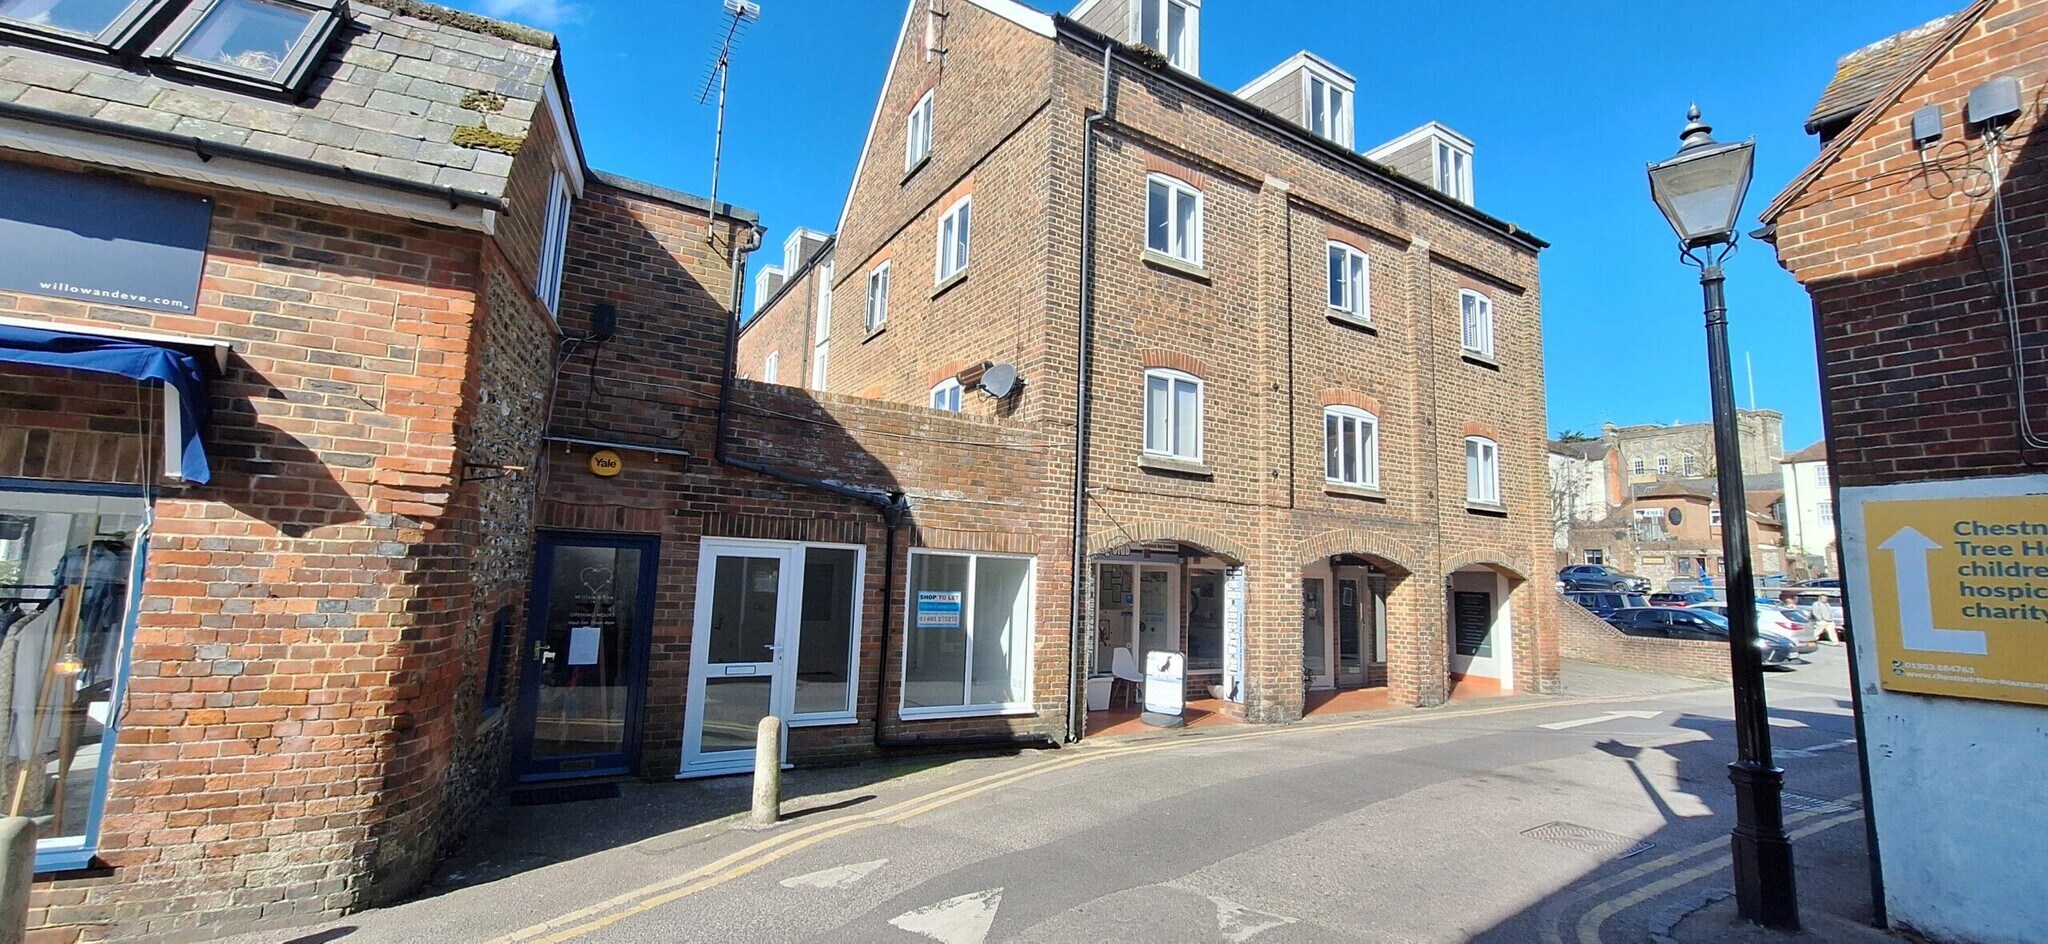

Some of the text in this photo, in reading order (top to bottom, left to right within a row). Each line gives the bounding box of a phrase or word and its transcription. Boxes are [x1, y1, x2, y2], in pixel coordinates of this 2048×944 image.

[595, 457, 617, 468] Yale
[1954, 540, 2048, 557] Tree H
[1957, 561, 2048, 578] childre
[1959, 581, 2048, 601] hospic
